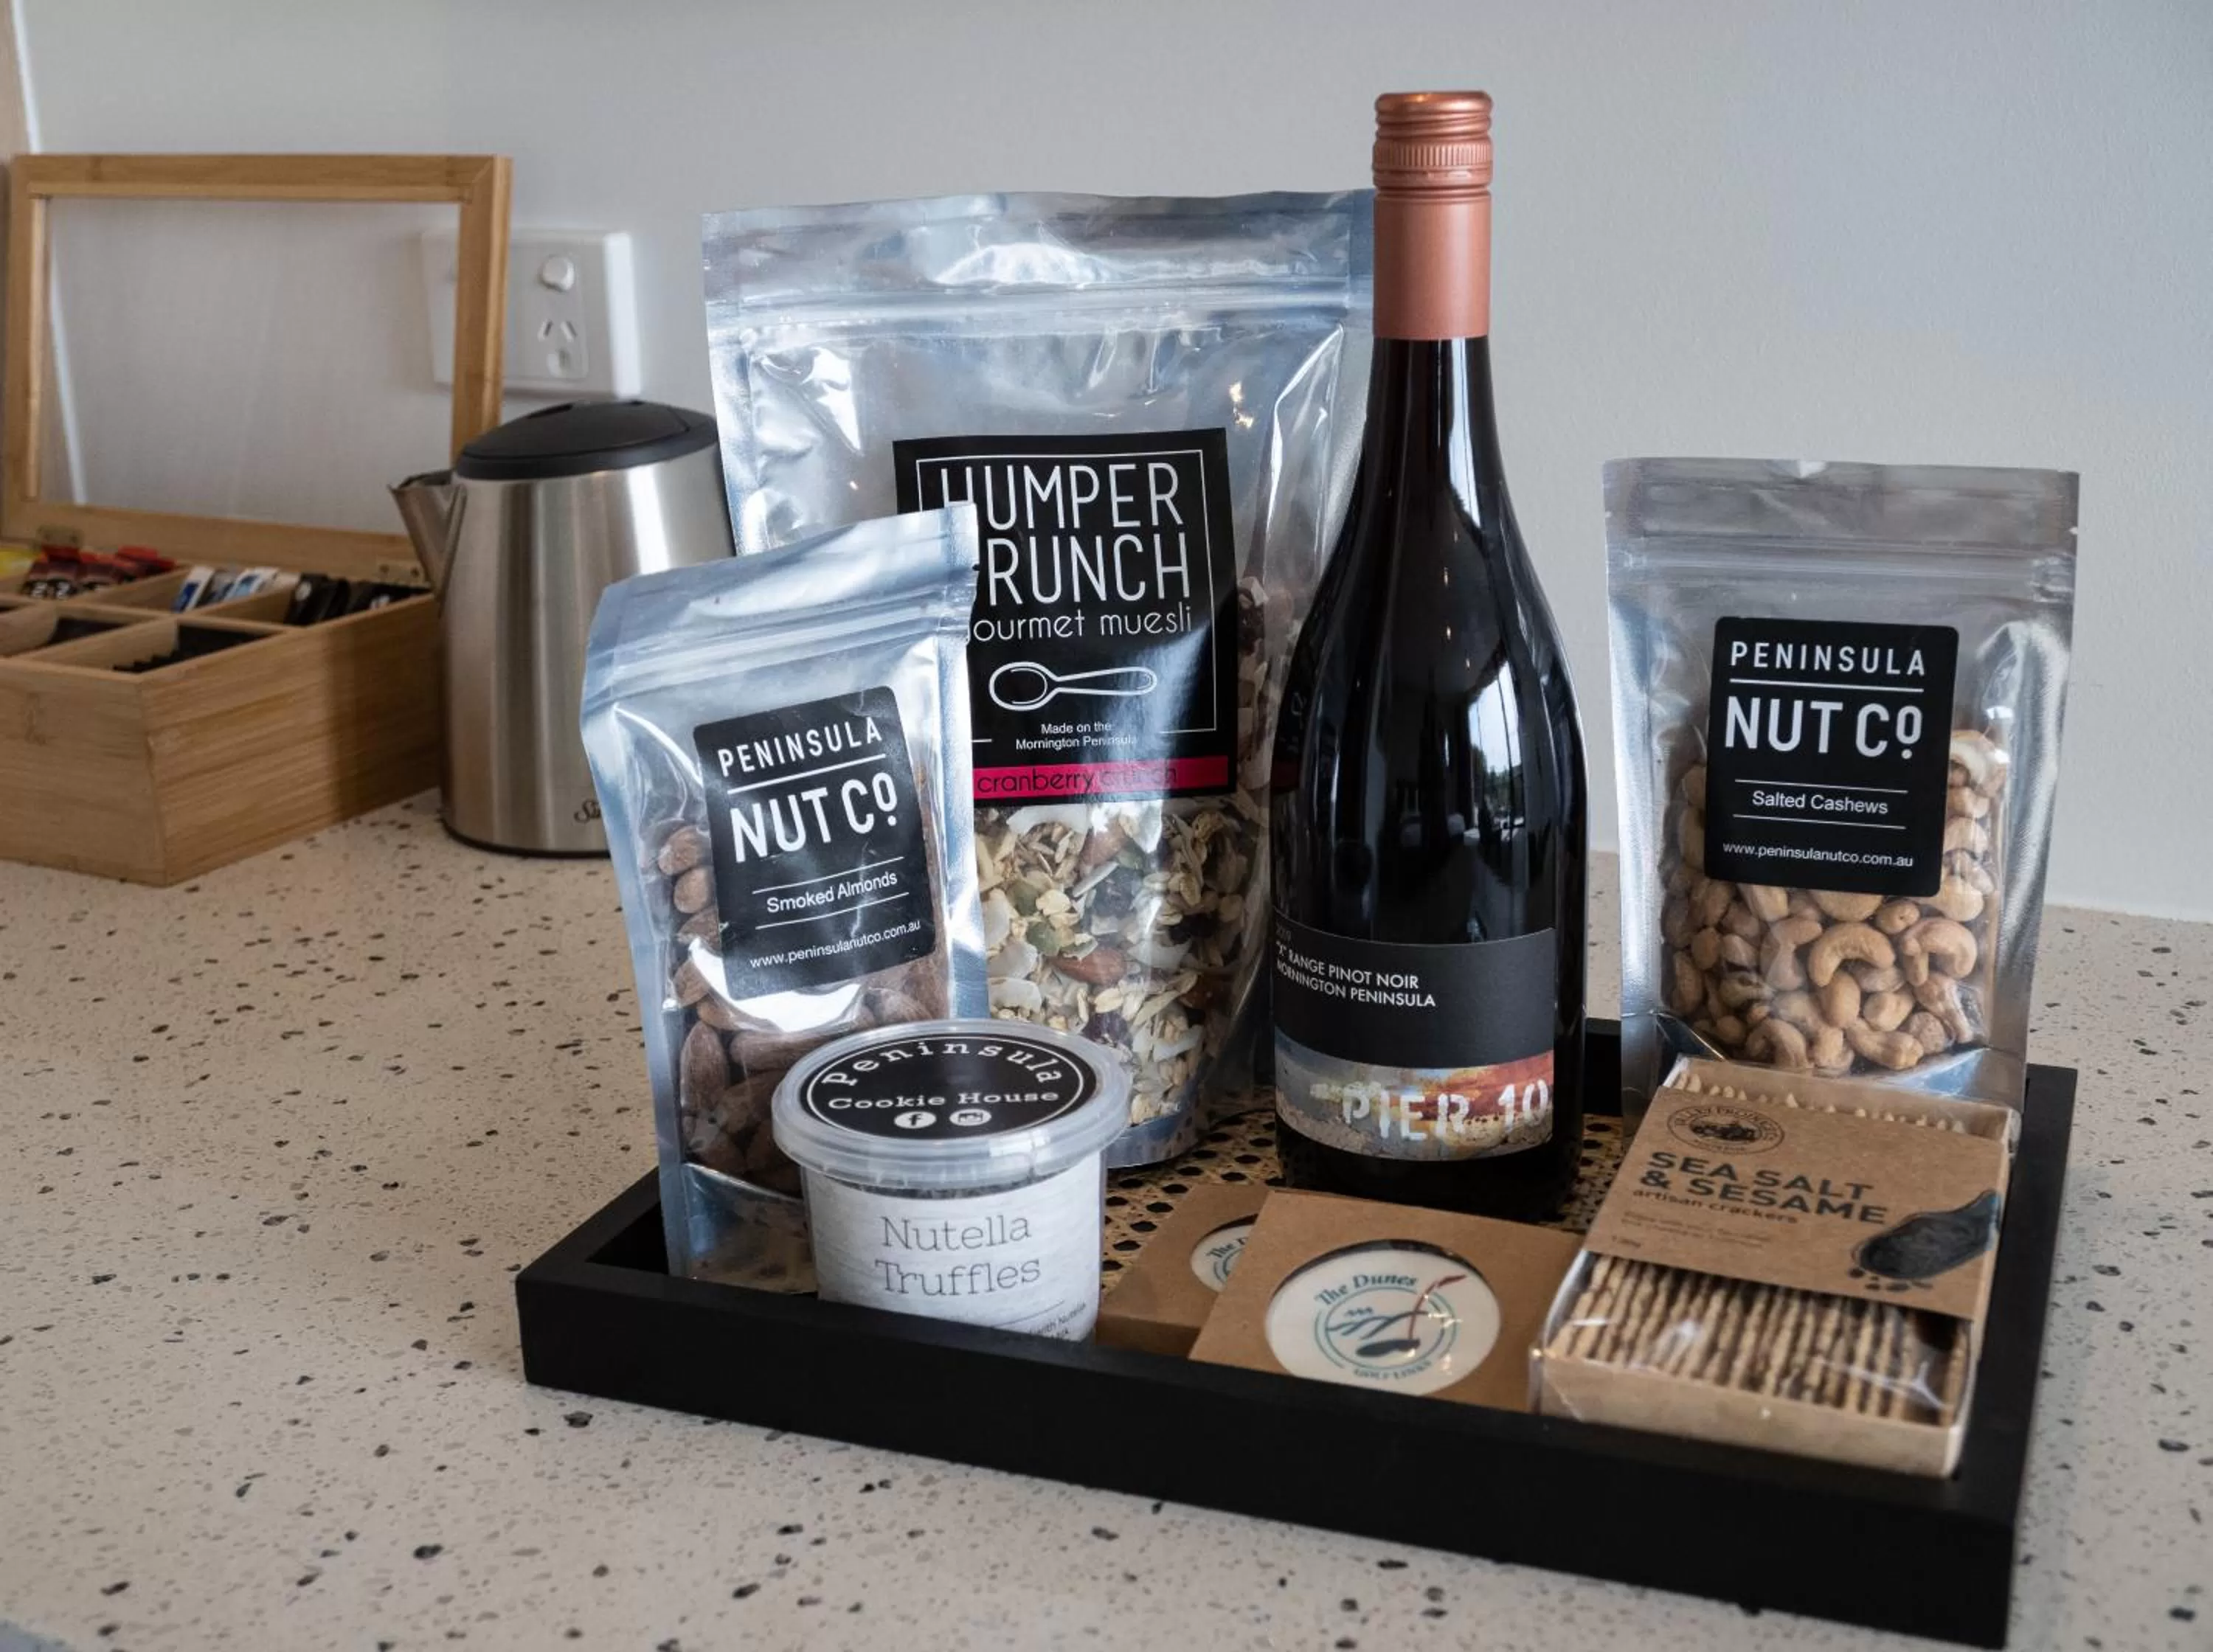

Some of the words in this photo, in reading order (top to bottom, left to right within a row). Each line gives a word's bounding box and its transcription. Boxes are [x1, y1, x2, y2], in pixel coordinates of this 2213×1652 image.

[986, 532, 1190, 606] RUNCH
[974, 609, 1084, 641] ourmet
[1101, 602, 1191, 636] muesli
[1731, 641, 1925, 676] PENINSULA
[1016, 736, 1079, 751] Mornington
[1083, 734, 1136, 747] Pennsul
[1041, 723, 1073, 734] Made
[1076, 723, 1090, 733] on
[1094, 721, 1112, 732] the
[1725, 695, 1843, 753] NUT
[718, 717, 882, 777] PENINSULA
[977, 765, 1095, 794] cranberry
[1100, 760, 1177, 787] crch
[1752, 790, 1805, 808] Salted
[1811, 794, 1888, 814] Cashews
[730, 788, 831, 863] NUT
[1722, 842, 1914, 867] www.peninsulanutco.com.au
[766, 886, 834, 913] Smoked
[837, 871, 898, 899] Almonds
[749, 920, 921, 968] www.peninsulanutco.com.au
[1277, 959, 1346, 999] MORNINGTON
[1351, 988, 1436, 1007] PENINSULA
[1289, 948, 1326, 976] RANGE
[1329, 965, 1372, 985] PINOT
[1376, 973, 1419, 989] NOIR
[820, 1041, 1062, 1088] Peninsula
[828, 1094, 946, 1109] Cookie
[957, 1091, 1059, 1105] House
[1342, 1082, 1470, 1142] PIER
[1498, 1079, 1548, 1134] 10
[1648, 1151, 1738, 1179] SEA
[1755, 1167, 1874, 1201] SALT
[1632, 1188, 1702, 1207] artisan
[1708, 1201, 1798, 1224] crackers
[1640, 1170, 1671, 1190] &
[1687, 1177, 1890, 1225] SESAME
[880, 1215, 1032, 1252] Nutella
[875, 1258, 1041, 1297] Truffles
[1314, 1284, 1348, 1305] The
[1352, 1273, 1418, 1288] Dunes
